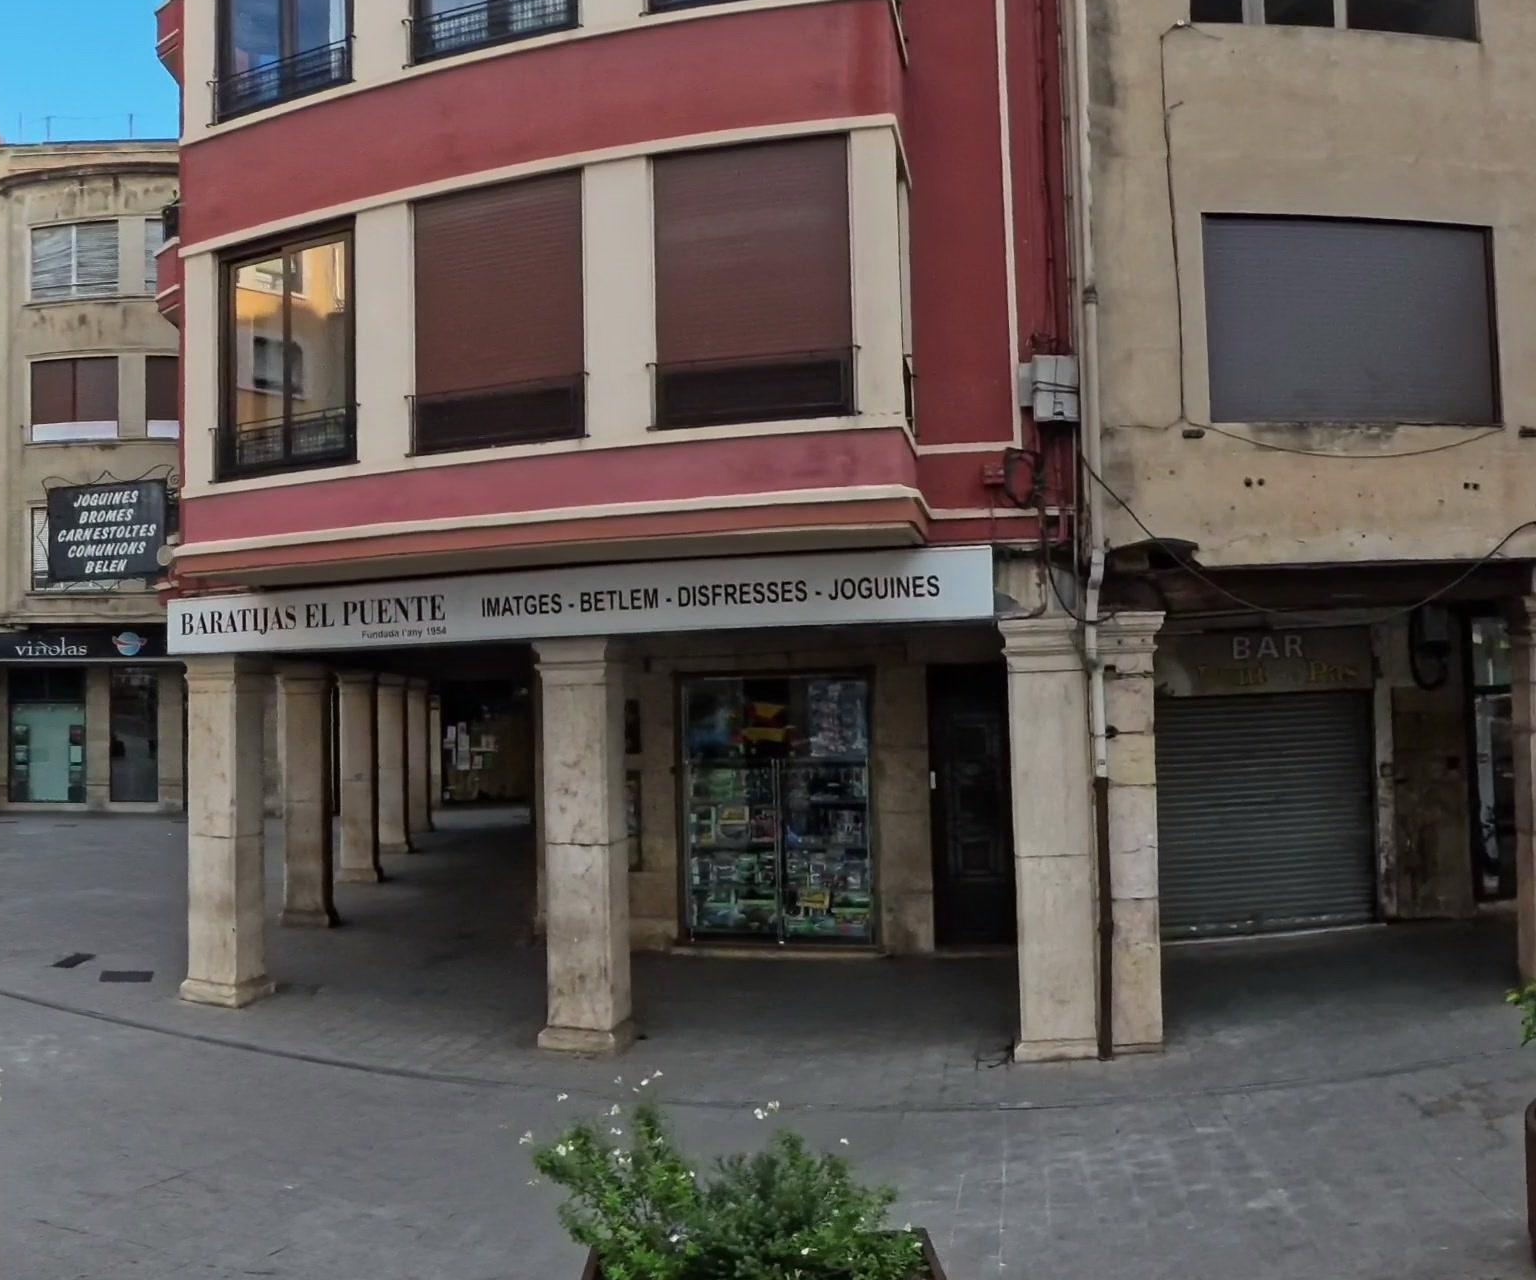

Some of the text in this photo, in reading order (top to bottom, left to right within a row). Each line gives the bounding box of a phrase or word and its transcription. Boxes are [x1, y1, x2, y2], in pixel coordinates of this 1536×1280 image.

[73, 490, 139, 508] JOGUINES
[79, 508, 135, 525] BROMES
[57, 523, 157, 543] CARNESTOLTES
[67, 541, 147, 559] COMUNIONS
[84, 558, 128, 574] BELEN
[481, 592, 563, 619] IMATGES
[579, 587, 660, 613] BETLEM
[677, 580, 808, 608] DISFRESSES
[828, 574, 941, 601] JOGUINES
[180, 594, 447, 636] BARATIJAS EL PUENTE
[361, 629, 399, 641] Fundada
[1231, 634, 1304, 660] BAR
